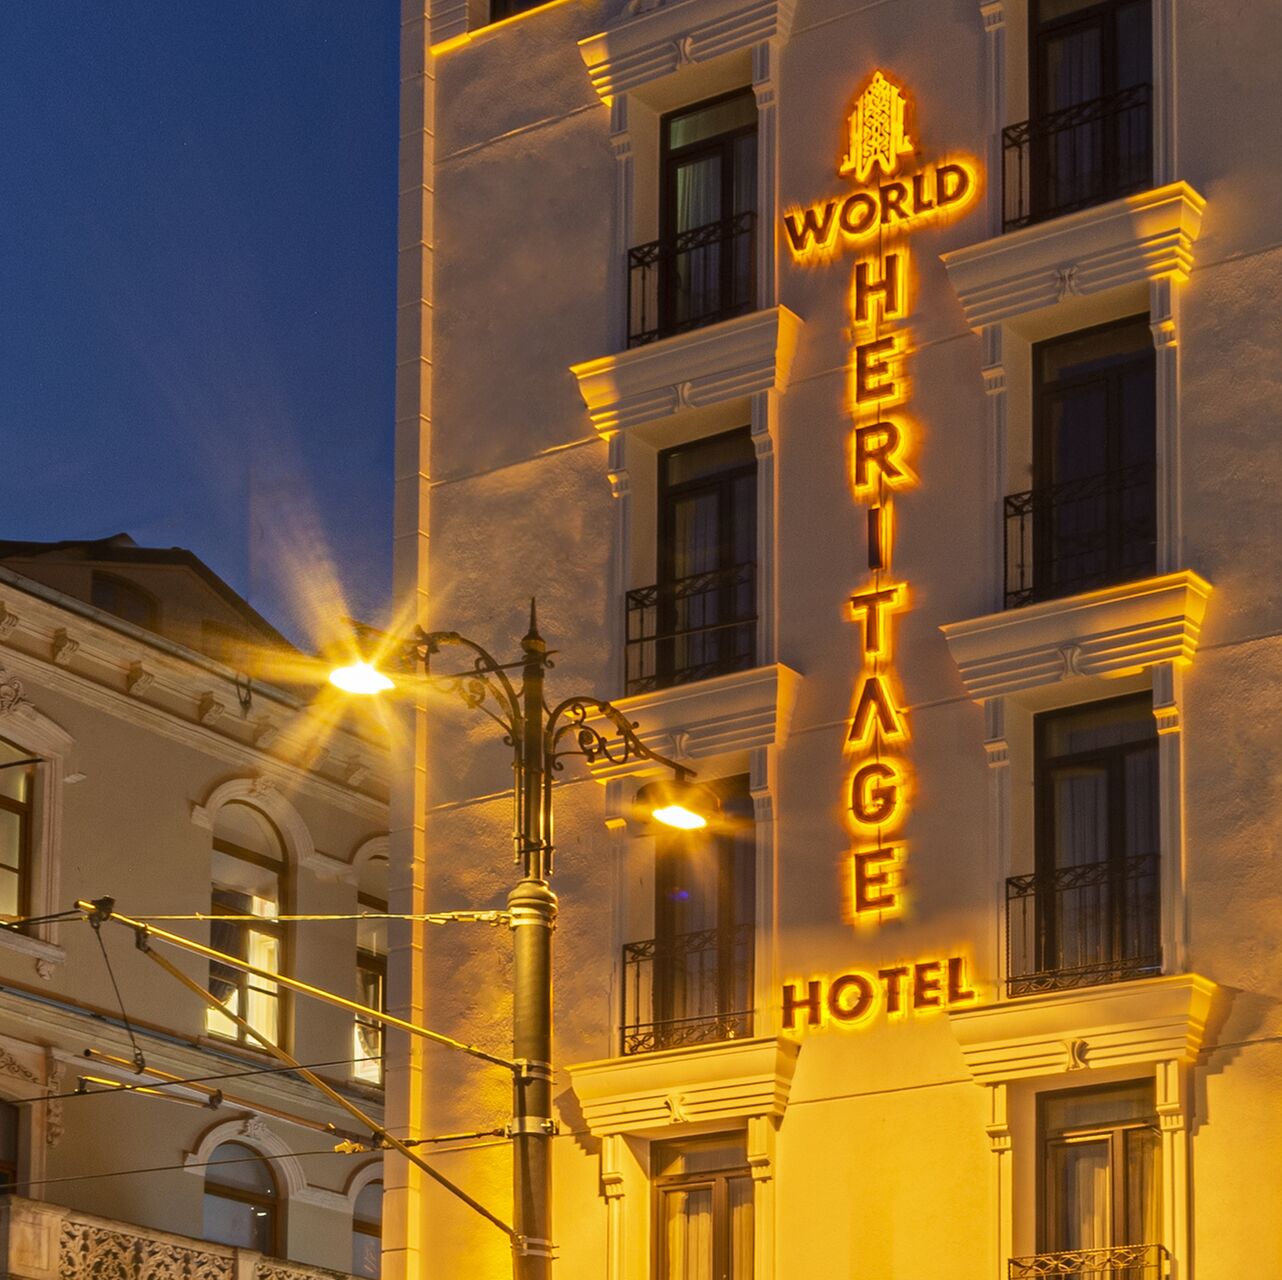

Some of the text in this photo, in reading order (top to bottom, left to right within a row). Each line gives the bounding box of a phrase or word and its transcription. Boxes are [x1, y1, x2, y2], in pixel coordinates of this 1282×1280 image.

[784, 164, 969, 251] WORLD
[849, 252, 902, 913] HERITAGE
[782, 957, 975, 1029] HOTEL
